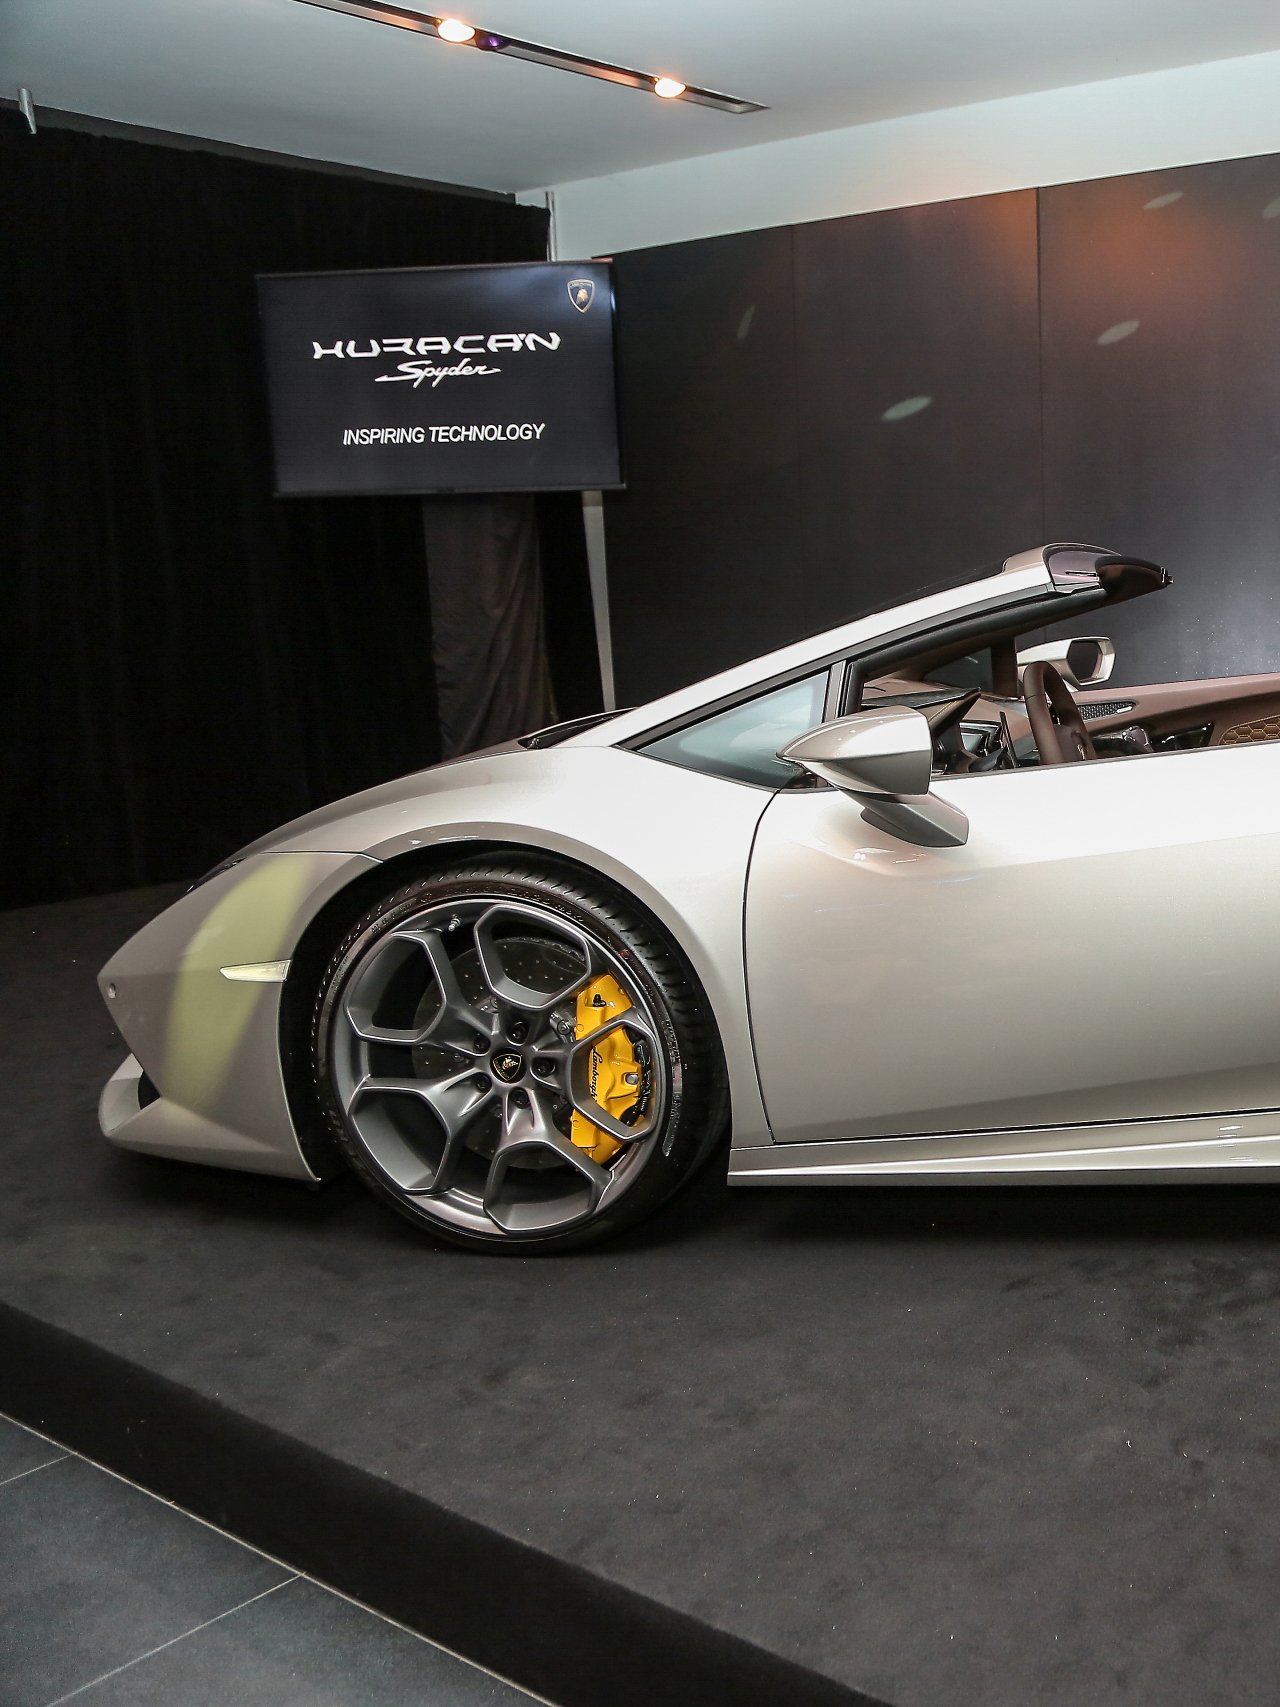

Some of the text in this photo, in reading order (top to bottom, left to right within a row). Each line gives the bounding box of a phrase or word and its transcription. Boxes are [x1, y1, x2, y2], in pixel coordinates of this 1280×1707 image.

[375, 358, 501, 388] Spyder
[343, 423, 546, 445] INSPIRING TECHNOLOGY
